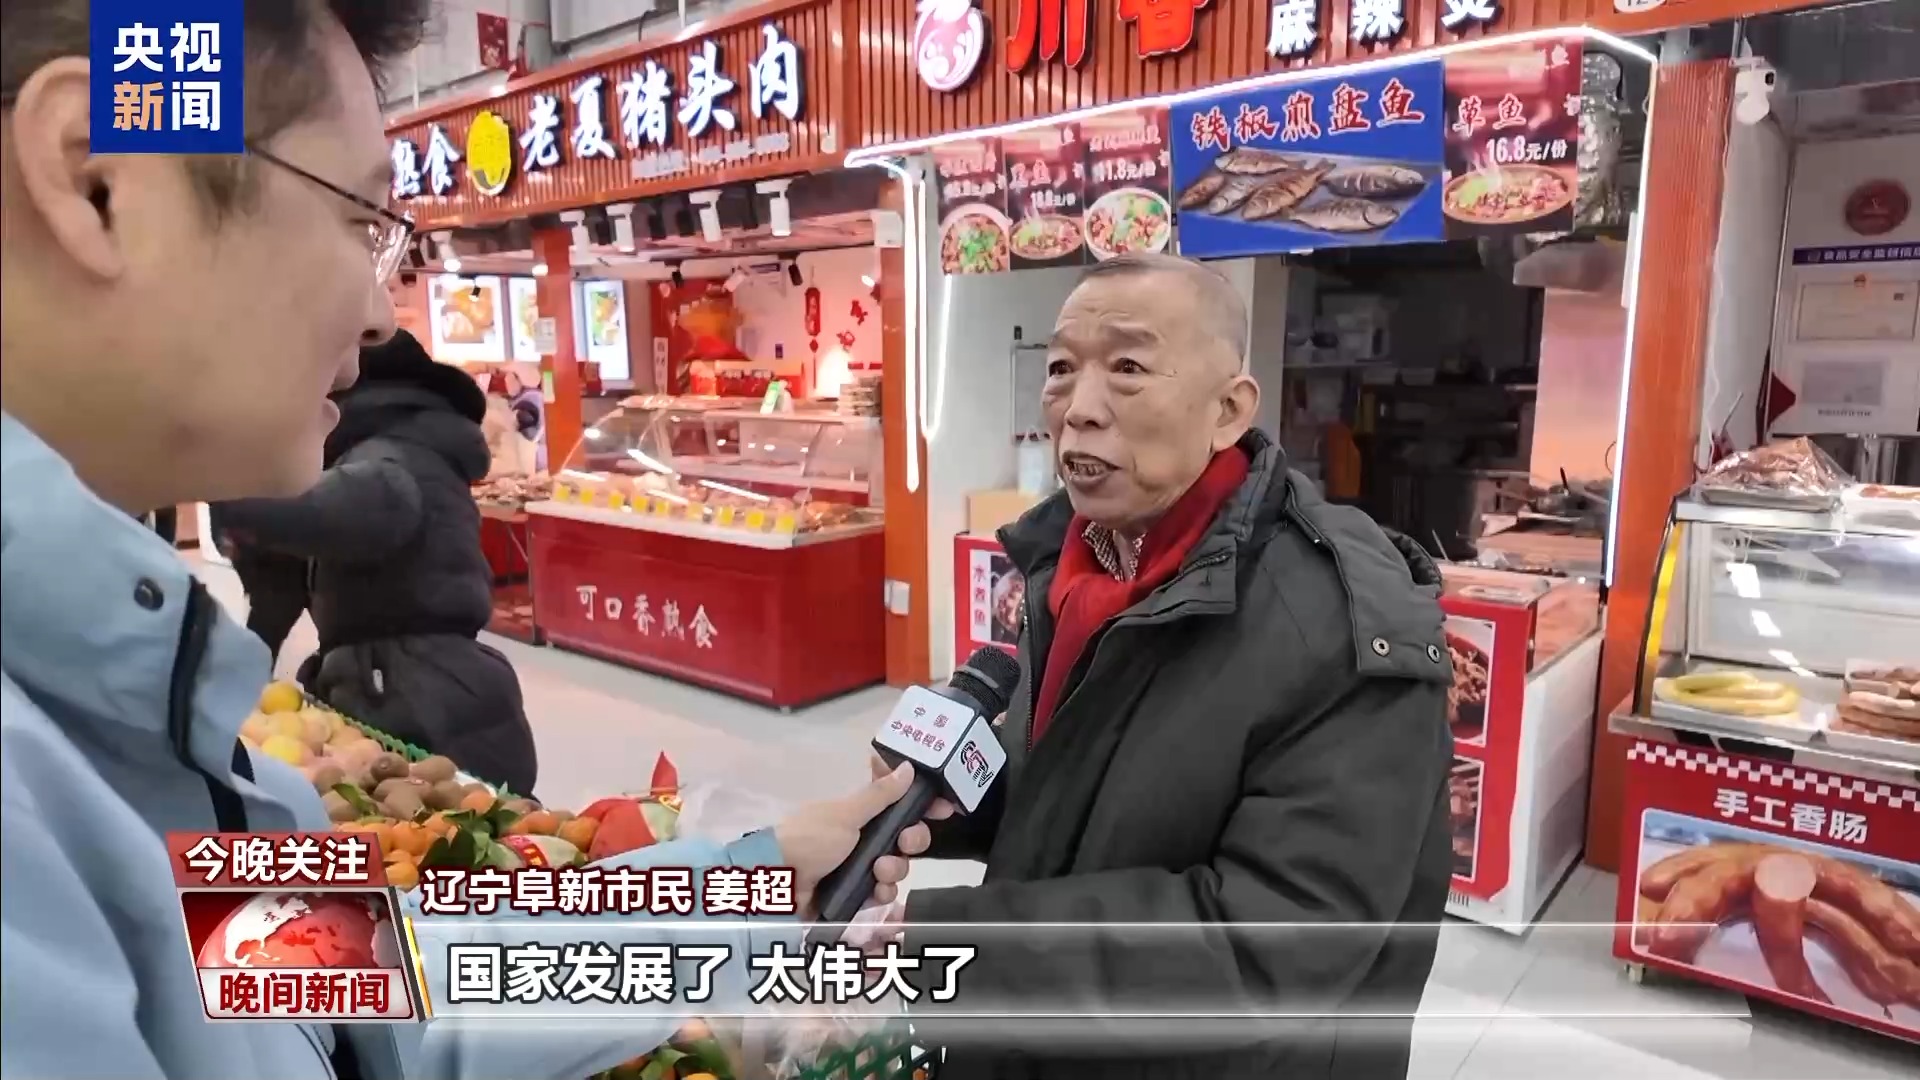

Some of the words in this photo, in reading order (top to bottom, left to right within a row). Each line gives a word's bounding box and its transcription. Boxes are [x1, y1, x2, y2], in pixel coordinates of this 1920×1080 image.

[519, 24, 802, 172] 老夏猪头肉
[1452, 93, 1527, 137] 草鱼
[1486, 135, 1568, 164] 16.8元/份
[576, 585, 719, 648] 可口香熟食
[890, 719, 946, 752] 中央电视台
[914, 706, 950, 729] 中国
[1713, 788, 1868, 844] 手工香肠
